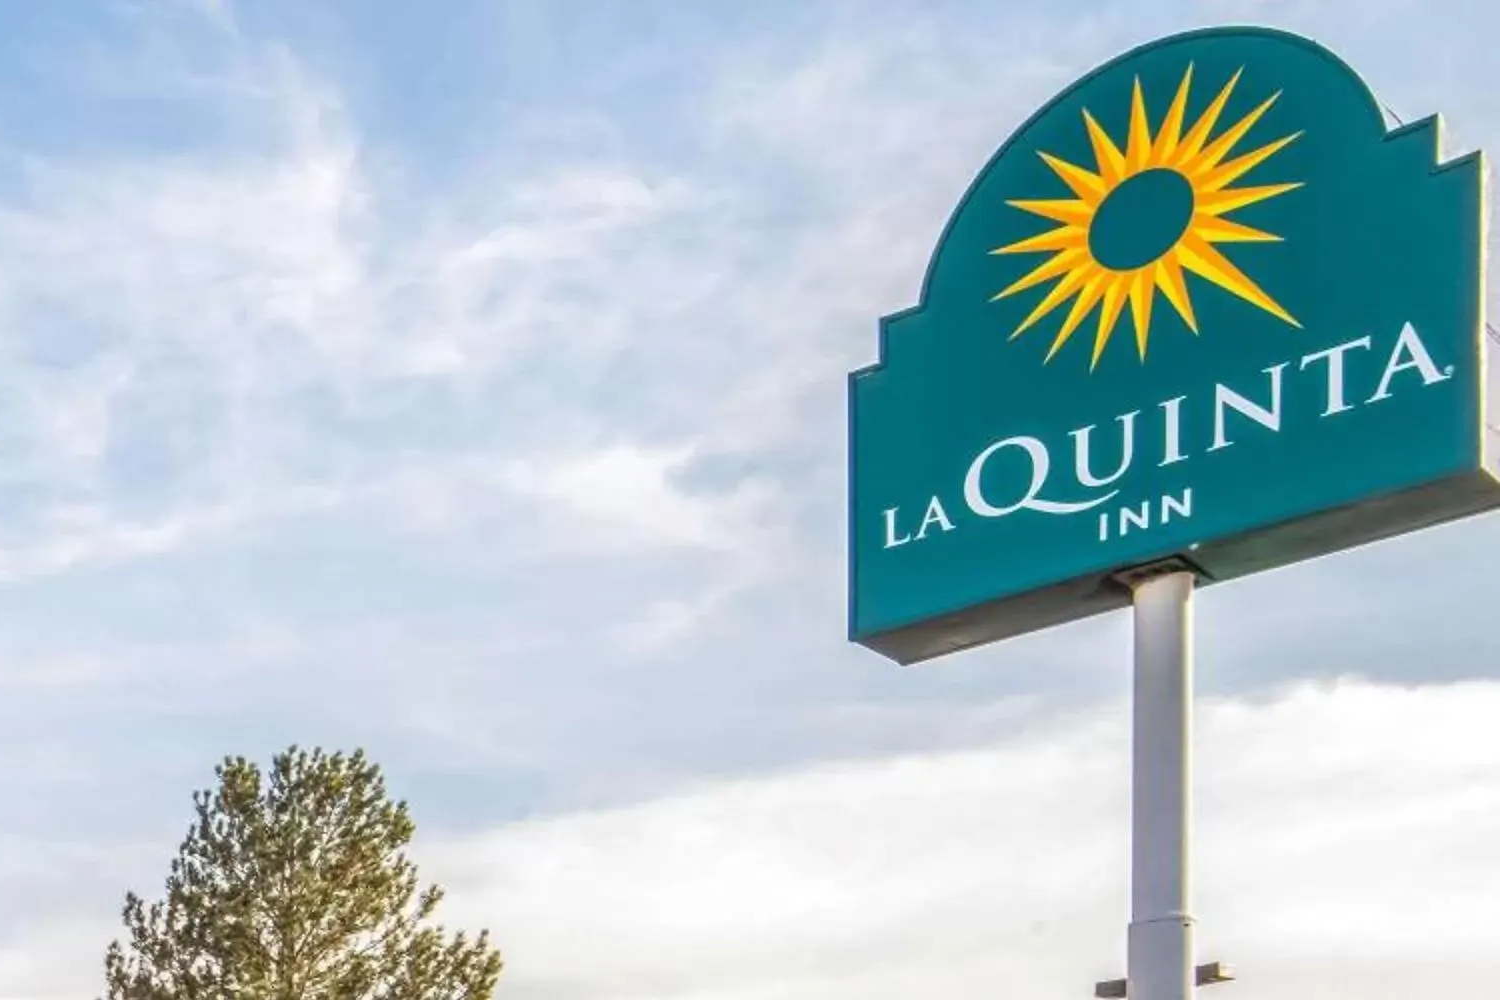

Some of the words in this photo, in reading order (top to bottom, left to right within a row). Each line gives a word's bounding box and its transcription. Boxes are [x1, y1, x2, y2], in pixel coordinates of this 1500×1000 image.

[884, 495, 956, 549] LA
[963, 321, 1452, 517] QUINTA
[1100, 488, 1192, 541] INN
